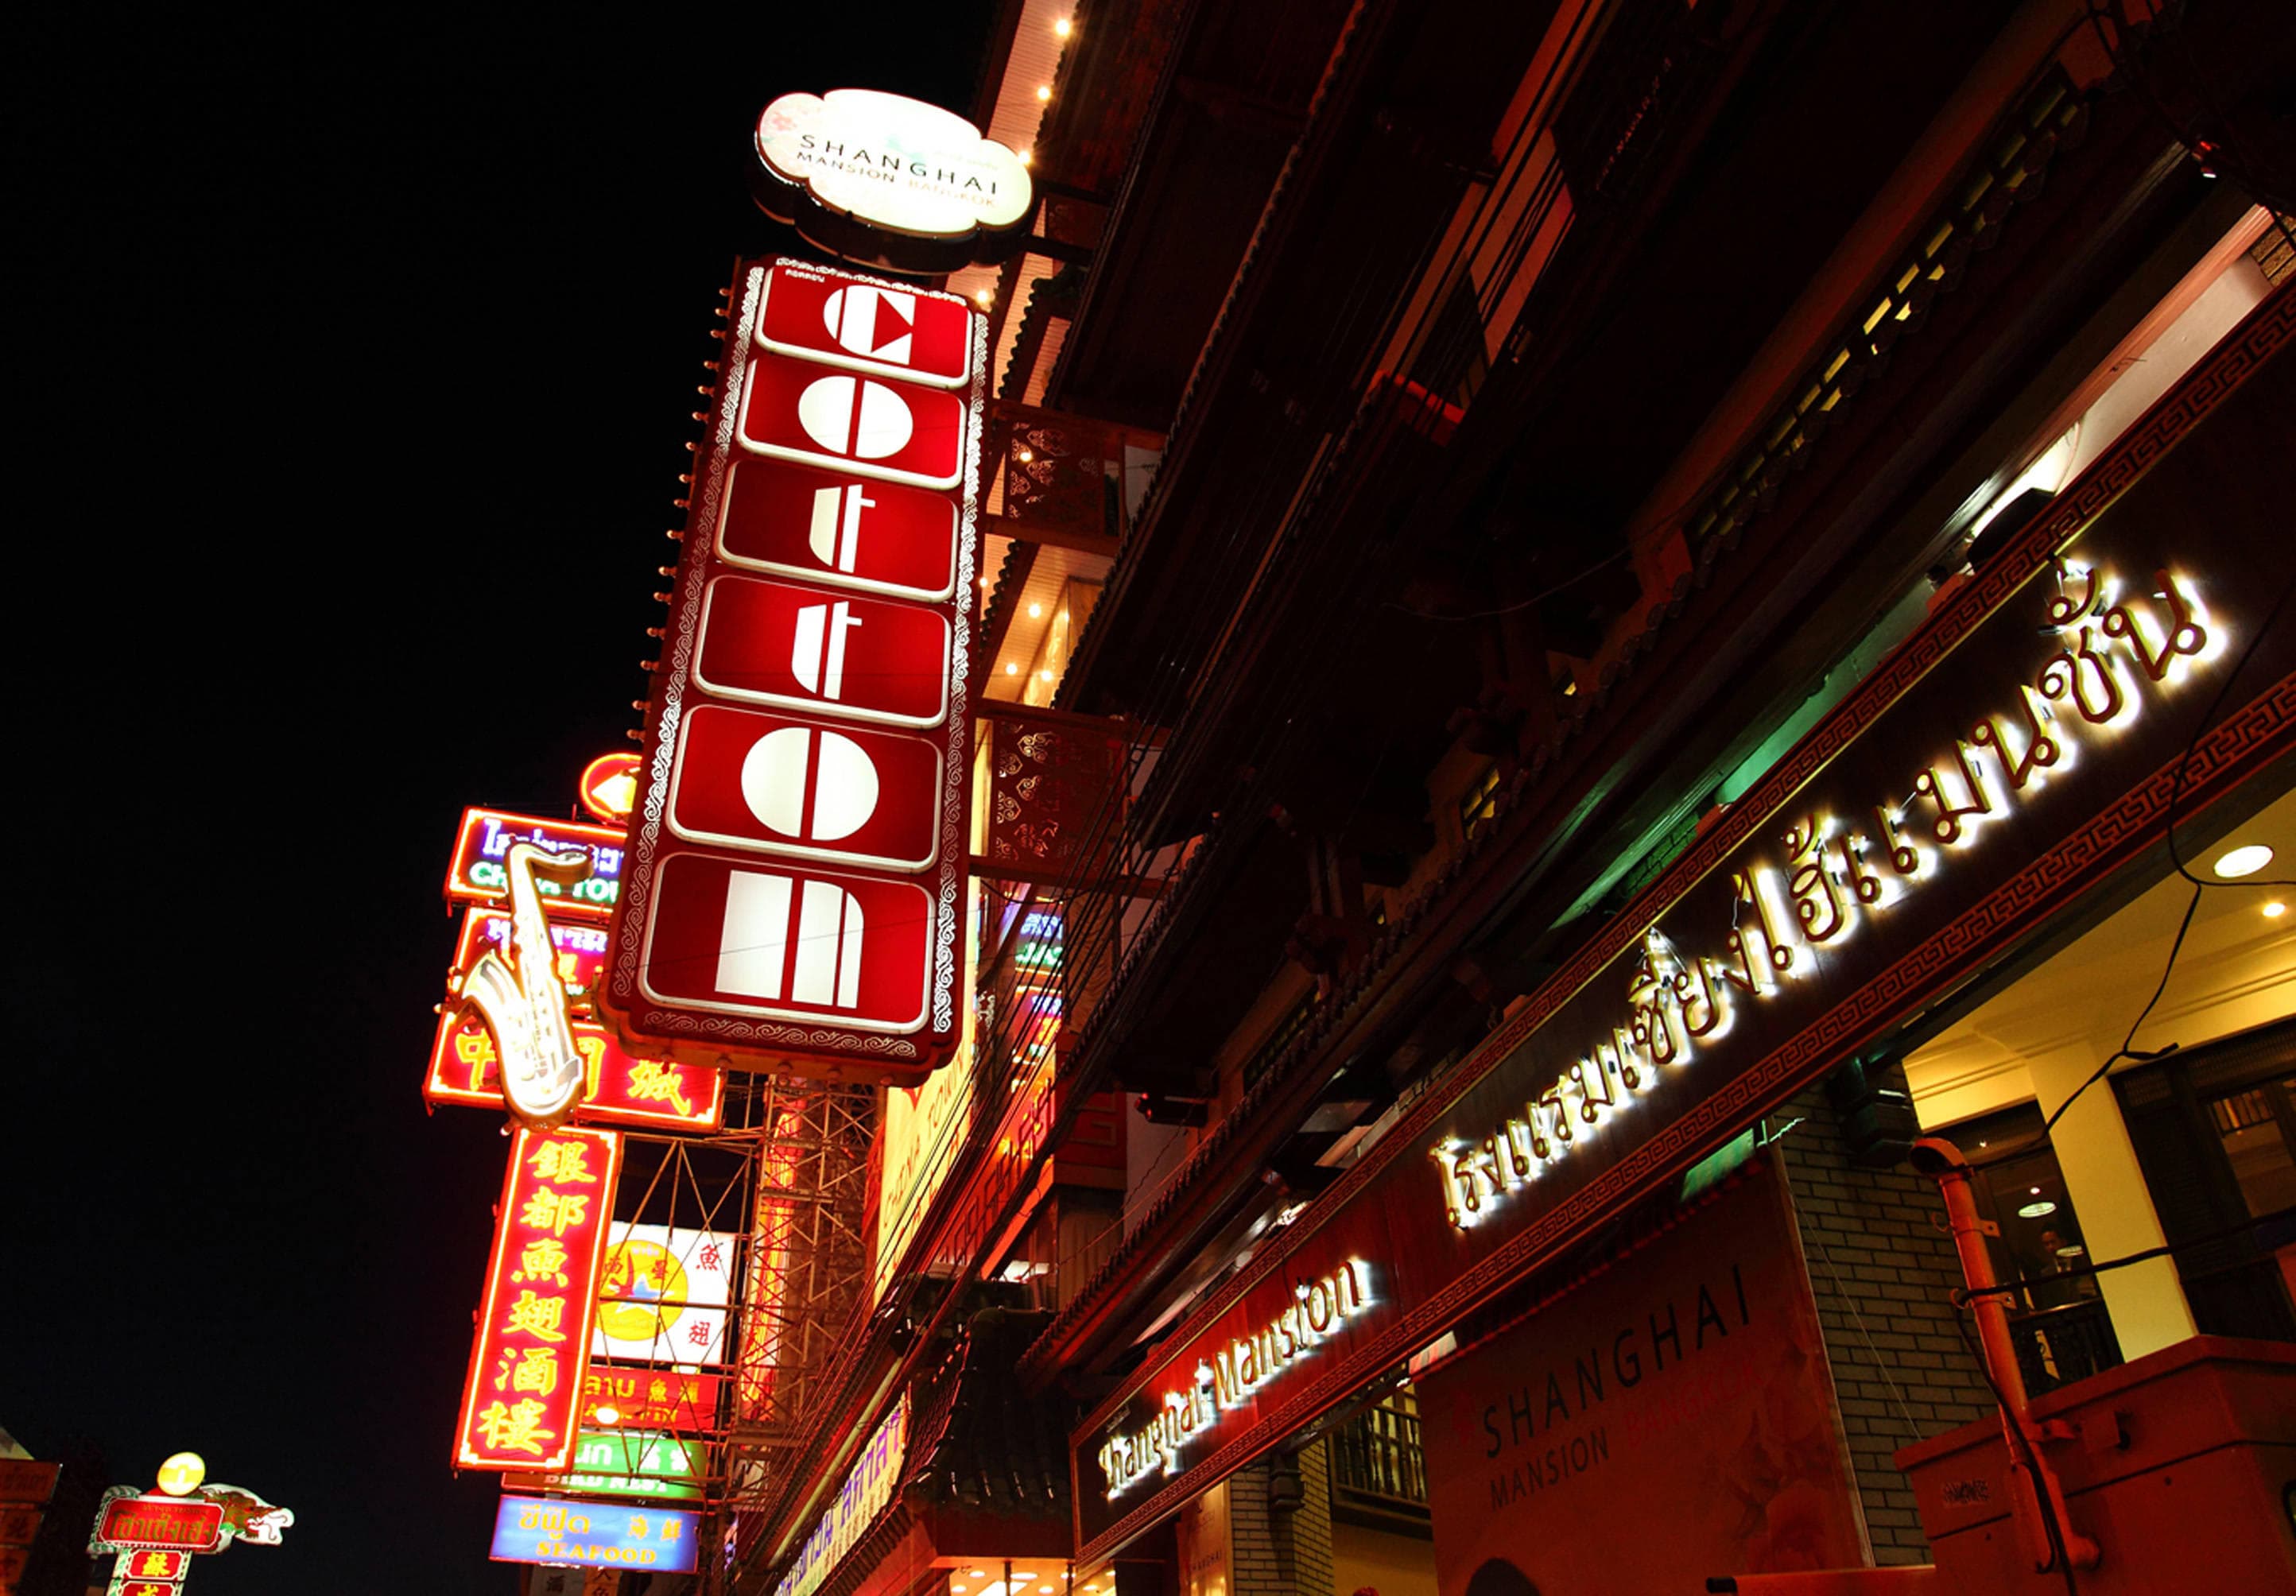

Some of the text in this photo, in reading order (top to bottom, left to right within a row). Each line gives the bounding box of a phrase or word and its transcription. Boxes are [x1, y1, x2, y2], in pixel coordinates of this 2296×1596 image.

[796, 151, 896, 184] MANSION
[800, 134, 997, 195] SHANGHAI
[478, 1139, 597, 1455] 銀都魚翅酒樓
[1099, 1261, 1363, 1497] Shanghai Mansion
[1483, 1264, 1750, 1459] SHANGHAI
[1490, 1427, 1609, 1511] MANSION
[537, 1540, 657, 1563] SEAFOOD
